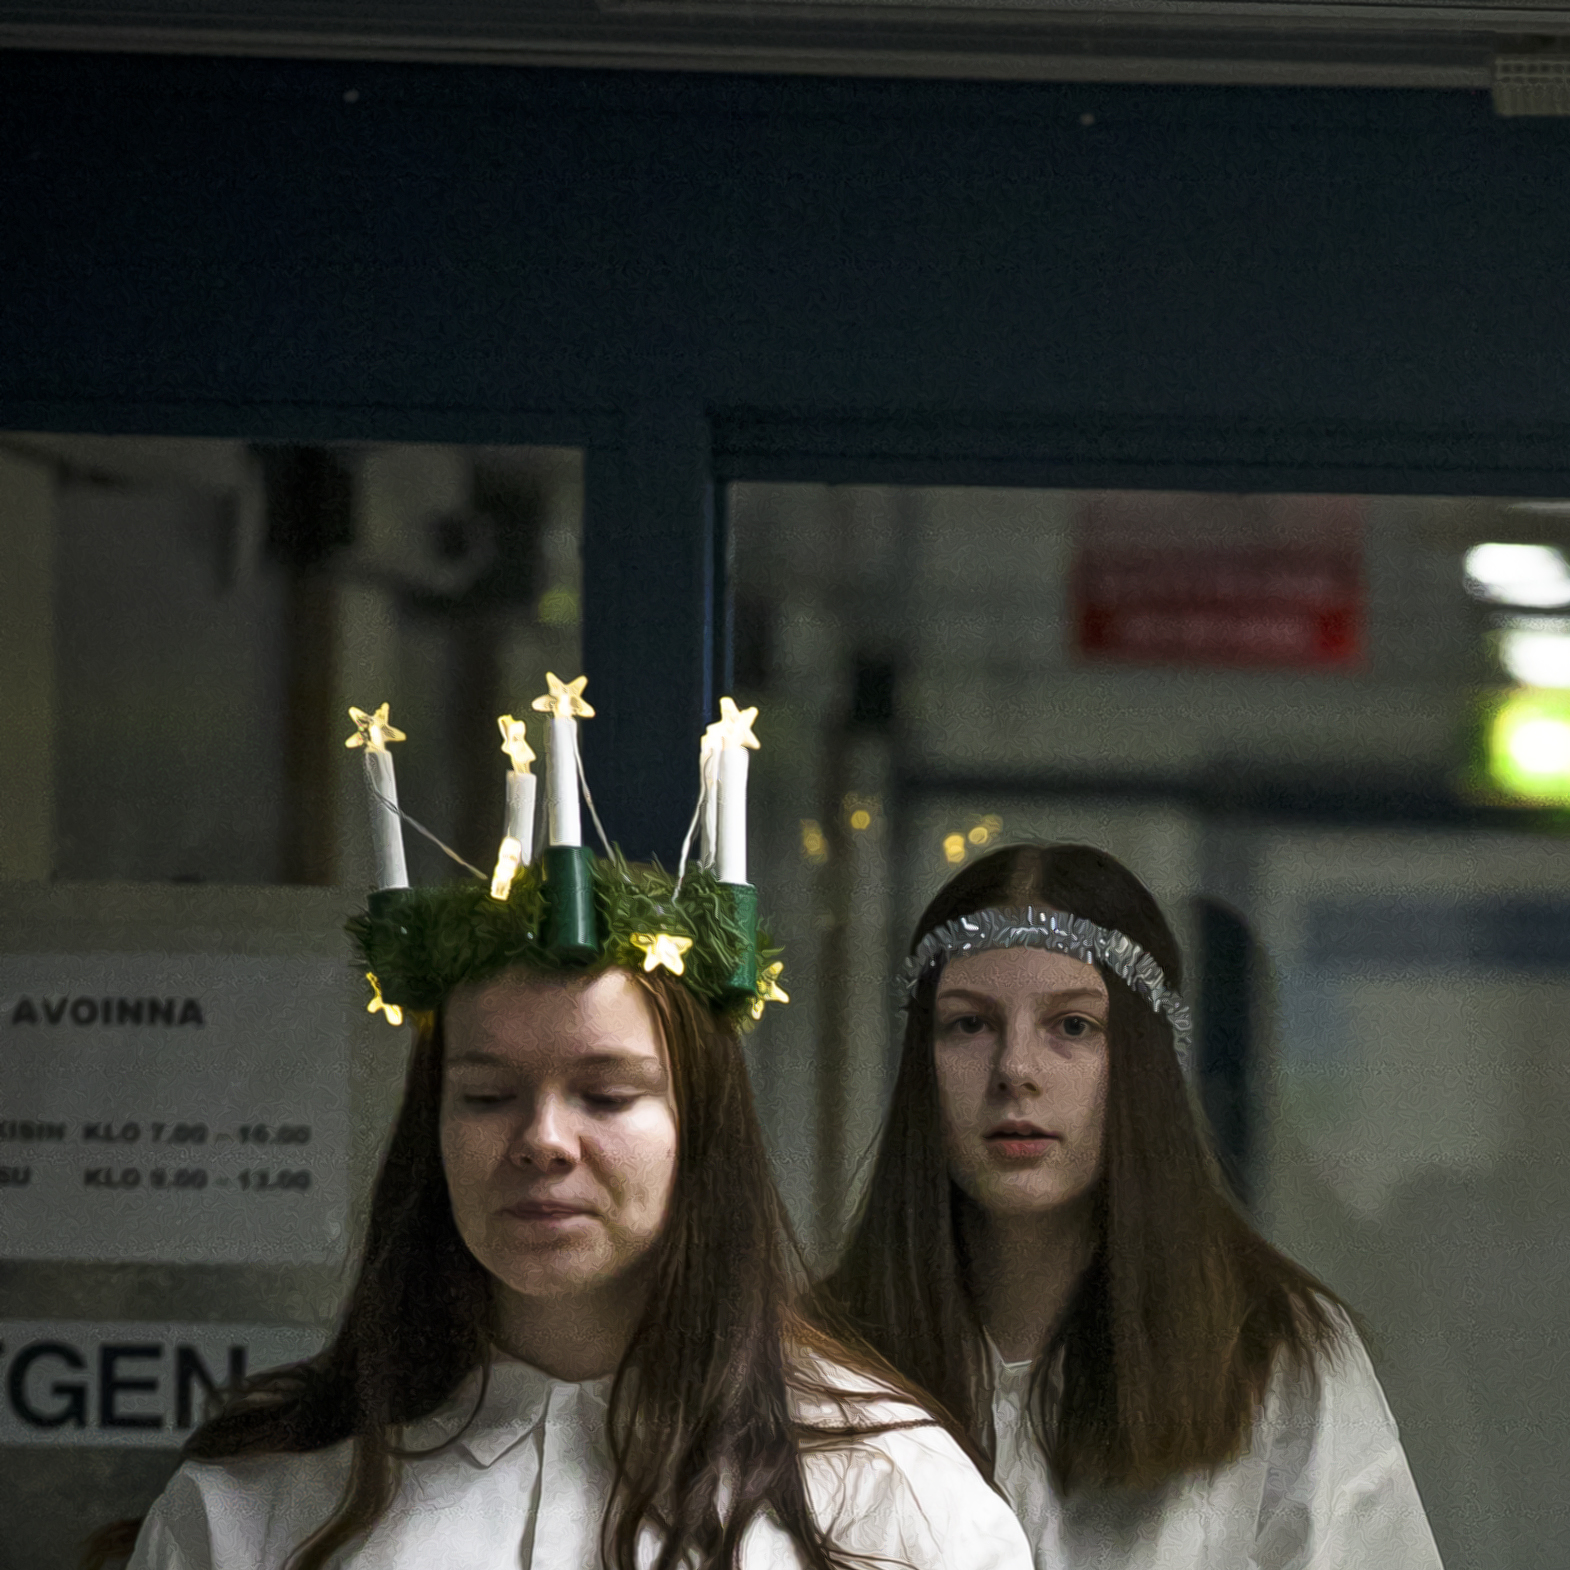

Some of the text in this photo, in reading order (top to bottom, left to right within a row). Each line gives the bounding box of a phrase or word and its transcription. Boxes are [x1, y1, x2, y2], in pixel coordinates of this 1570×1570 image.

[12, 997, 205, 1026] AVOINNA
[83, 1121, 142, 1144] KLO
[150, 1121, 209, 1145] 7.00
[238, 1122, 312, 1145] 16.00
[83, 1167, 142, 1190] KLO
[0, 1339, 246, 1431] GEN
